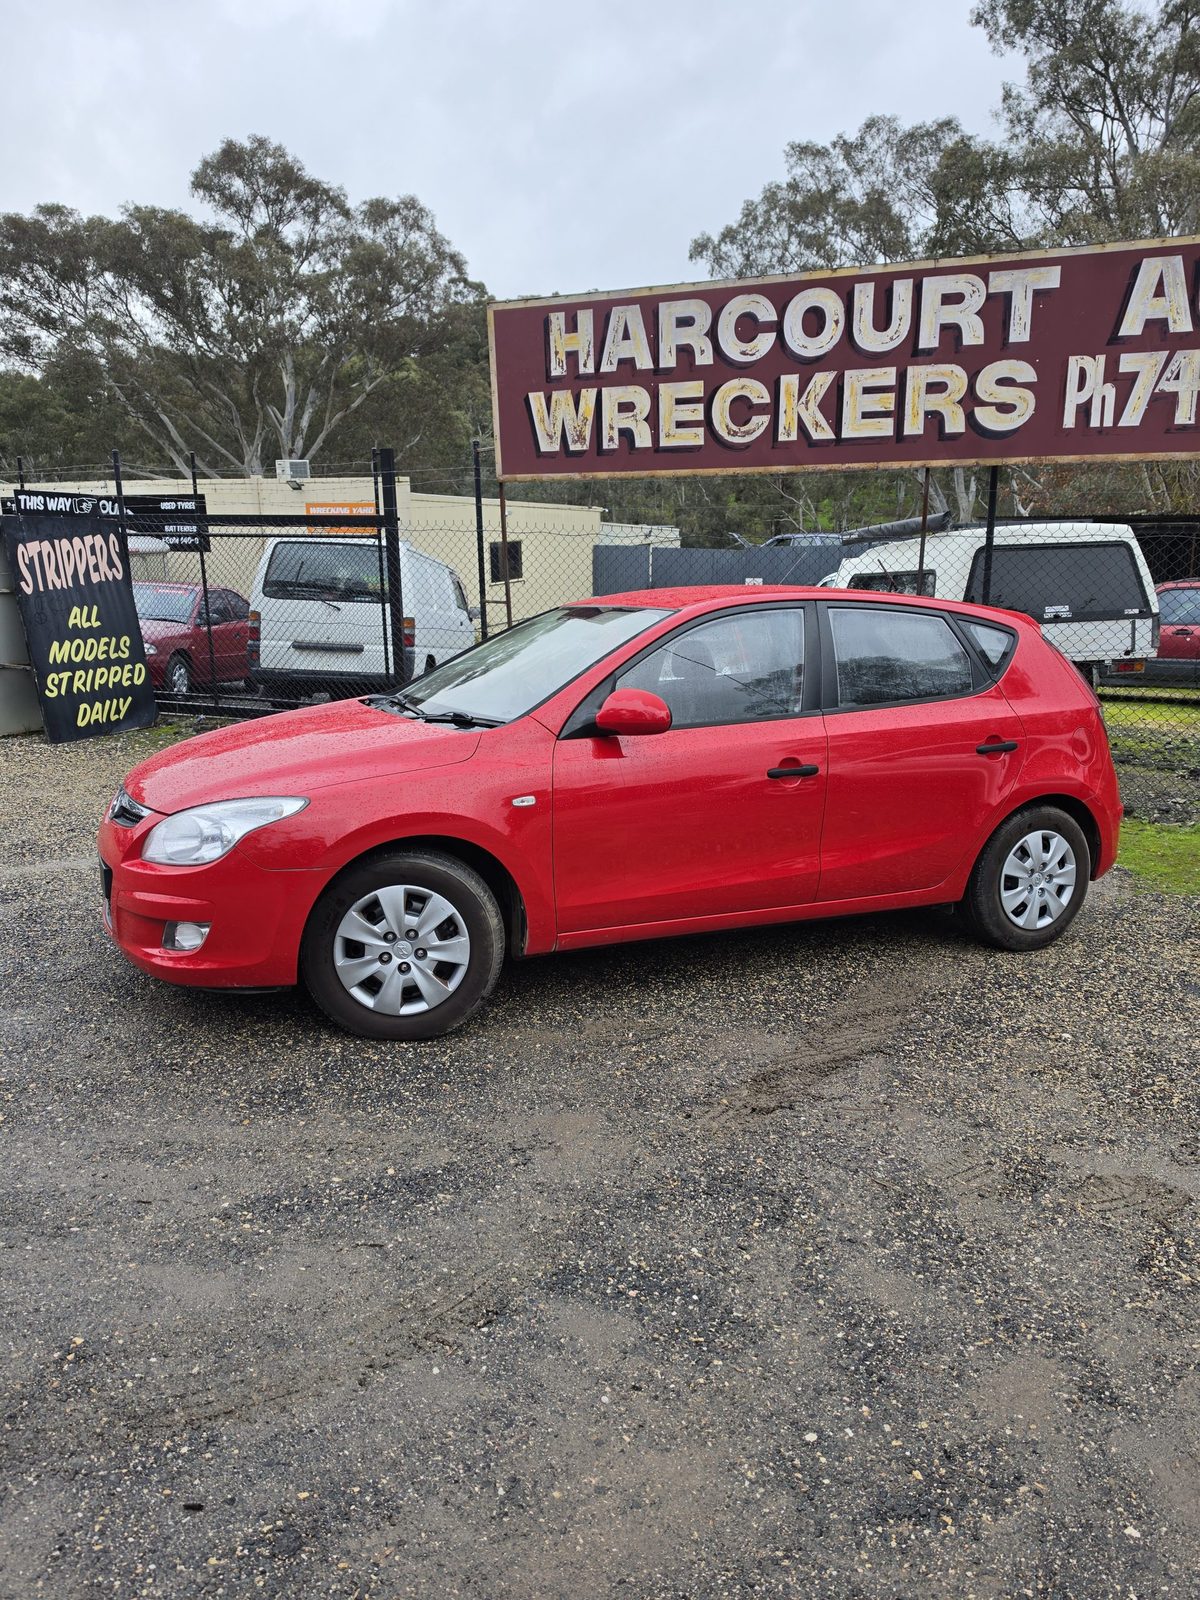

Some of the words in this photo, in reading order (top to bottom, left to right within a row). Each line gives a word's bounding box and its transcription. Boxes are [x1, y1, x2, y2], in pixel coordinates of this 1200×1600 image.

[548, 265, 1062, 377] HARCOURT
[1118, 254, 1200, 337] A
[528, 359, 1039, 453] WRECKERS
[18, 495, 45, 511] THIS
[46, 497, 71, 511] WAY
[160, 501, 176, 510] USED
[177, 501, 196, 510] TYRES
[309, 506, 349, 514] WRECKING
[352, 506, 374, 514] YARD
[17, 533, 123, 595] STRIPPERS
[68, 605, 101, 629] ALL
[49, 635, 130, 665] MODELS
[44, 663, 146, 698] STRIPPED
[76, 696, 132, 728] DAILY
